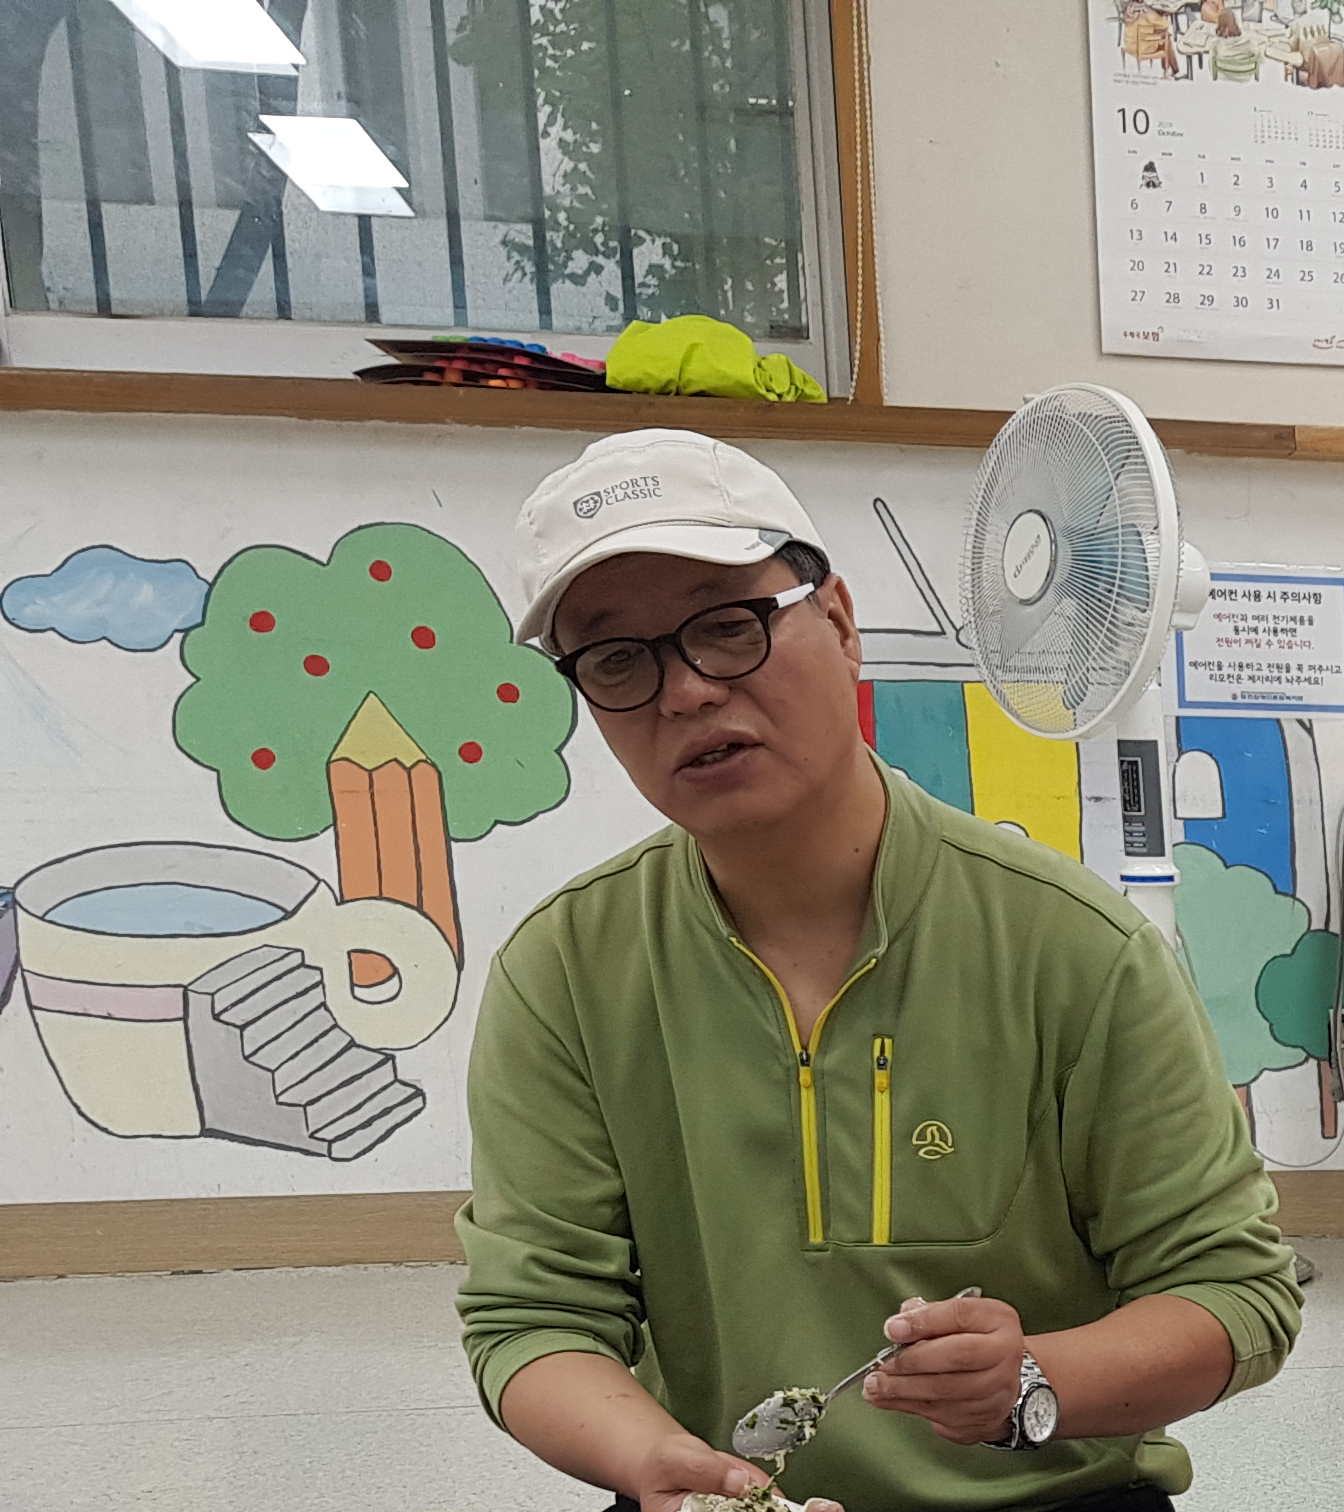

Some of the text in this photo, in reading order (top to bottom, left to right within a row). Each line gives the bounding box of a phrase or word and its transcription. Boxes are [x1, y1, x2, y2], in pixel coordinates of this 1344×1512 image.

[1117, 107, 1150, 136] 10
[1199, 172, 1341, 193] 1 2 3 4 5
[1130, 199, 1139, 211] 6
[1164, 200, 1173, 212] 7
[1199, 203, 1207, 215] 8
[1233, 205, 1241, 217] 9
[1264, 207, 1279, 220] 10
[1298, 209, 1311, 222] 11
[1128, 229, 1143, 241] 13
[1163, 231, 1178, 243] 14
[1198, 233, 1212, 246] 15
[1232, 235, 1246, 247] 16
[1265, 238, 1279, 250] 17
[1299, 239, 1313, 252] 18
[1129, 260, 1145, 272] 20
[1163, 262, 1178, 274] 21
[1198, 264, 1213, 276] 22
[1232, 266, 1247, 278] 23
[1265, 268, 1281, 280] 24
[1299, 270, 1314, 282] 25
[1130, 290, 1281, 310] 27 28 29 30 31
[602, 475, 661, 498] SPORTS
[604, 487, 663, 506] CLASSIC
[1241, 590, 1262, 602] 사용
[1267, 591, 1276, 602] 시
[1280, 591, 1322, 604] 주의사항
[1213, 612, 1314, 626] 에어컨과 여러 전기제품을
[1233, 626, 1297, 637] 동시에 사용하면
[1216, 637, 1241, 648] 전원이
[1265, 638, 1274, 647] 수
[1277, 639, 1315, 650] 있습니다.
[1189, 660, 1223, 671] 에어컨을
[1227, 661, 1263, 672] 사용하고
[1267, 663, 1291, 674] 전원을
[1209, 674, 1244, 684] 리모컨은
[1247, 674, 1282, 685] 제자리에
